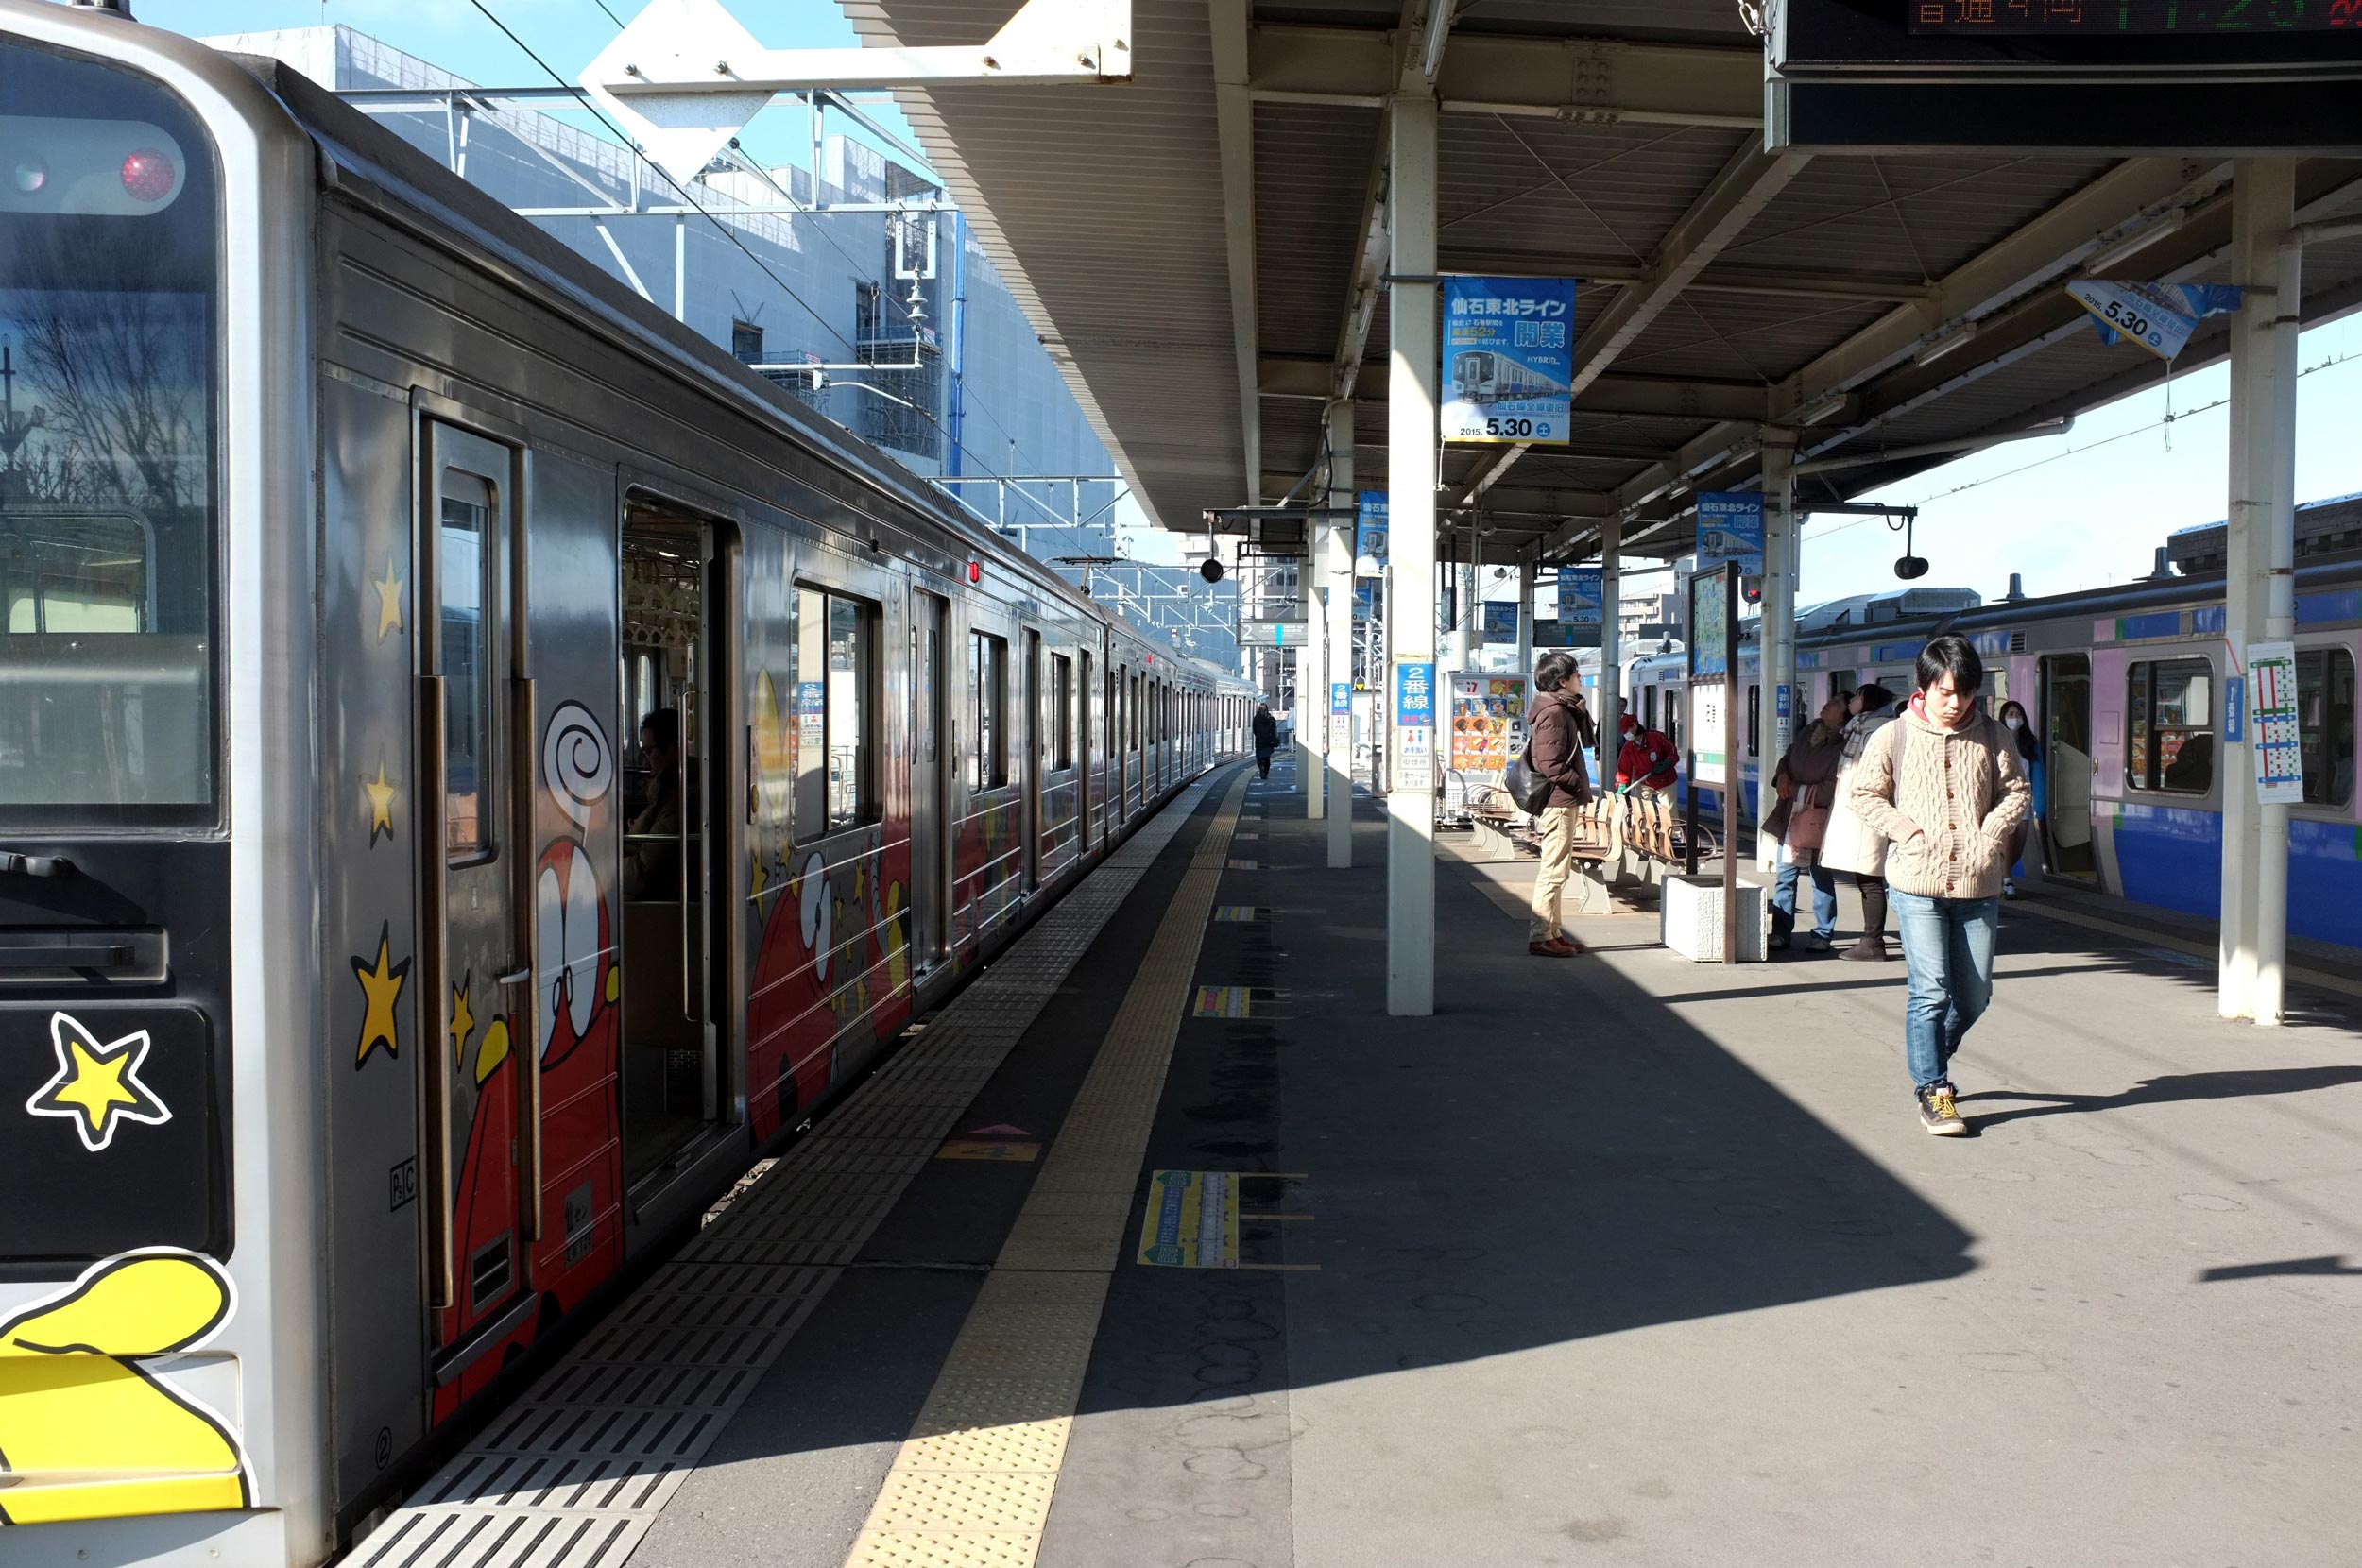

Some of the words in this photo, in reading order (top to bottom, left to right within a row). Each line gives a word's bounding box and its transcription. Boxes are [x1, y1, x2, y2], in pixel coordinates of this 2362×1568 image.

[1451, 298, 1566, 317] 仙石東北ライン
[2105, 300, 2148, 336] 5.30
[1515, 320, 1566, 349] 開業
[1486, 418, 1532, 437] 5.30
[1538, 425, 1549, 435] 土
[1242, 624, 1253, 639] 2
[1334, 685, 1349, 708] 2番線
[1402, 667, 1429, 710] 2番線
